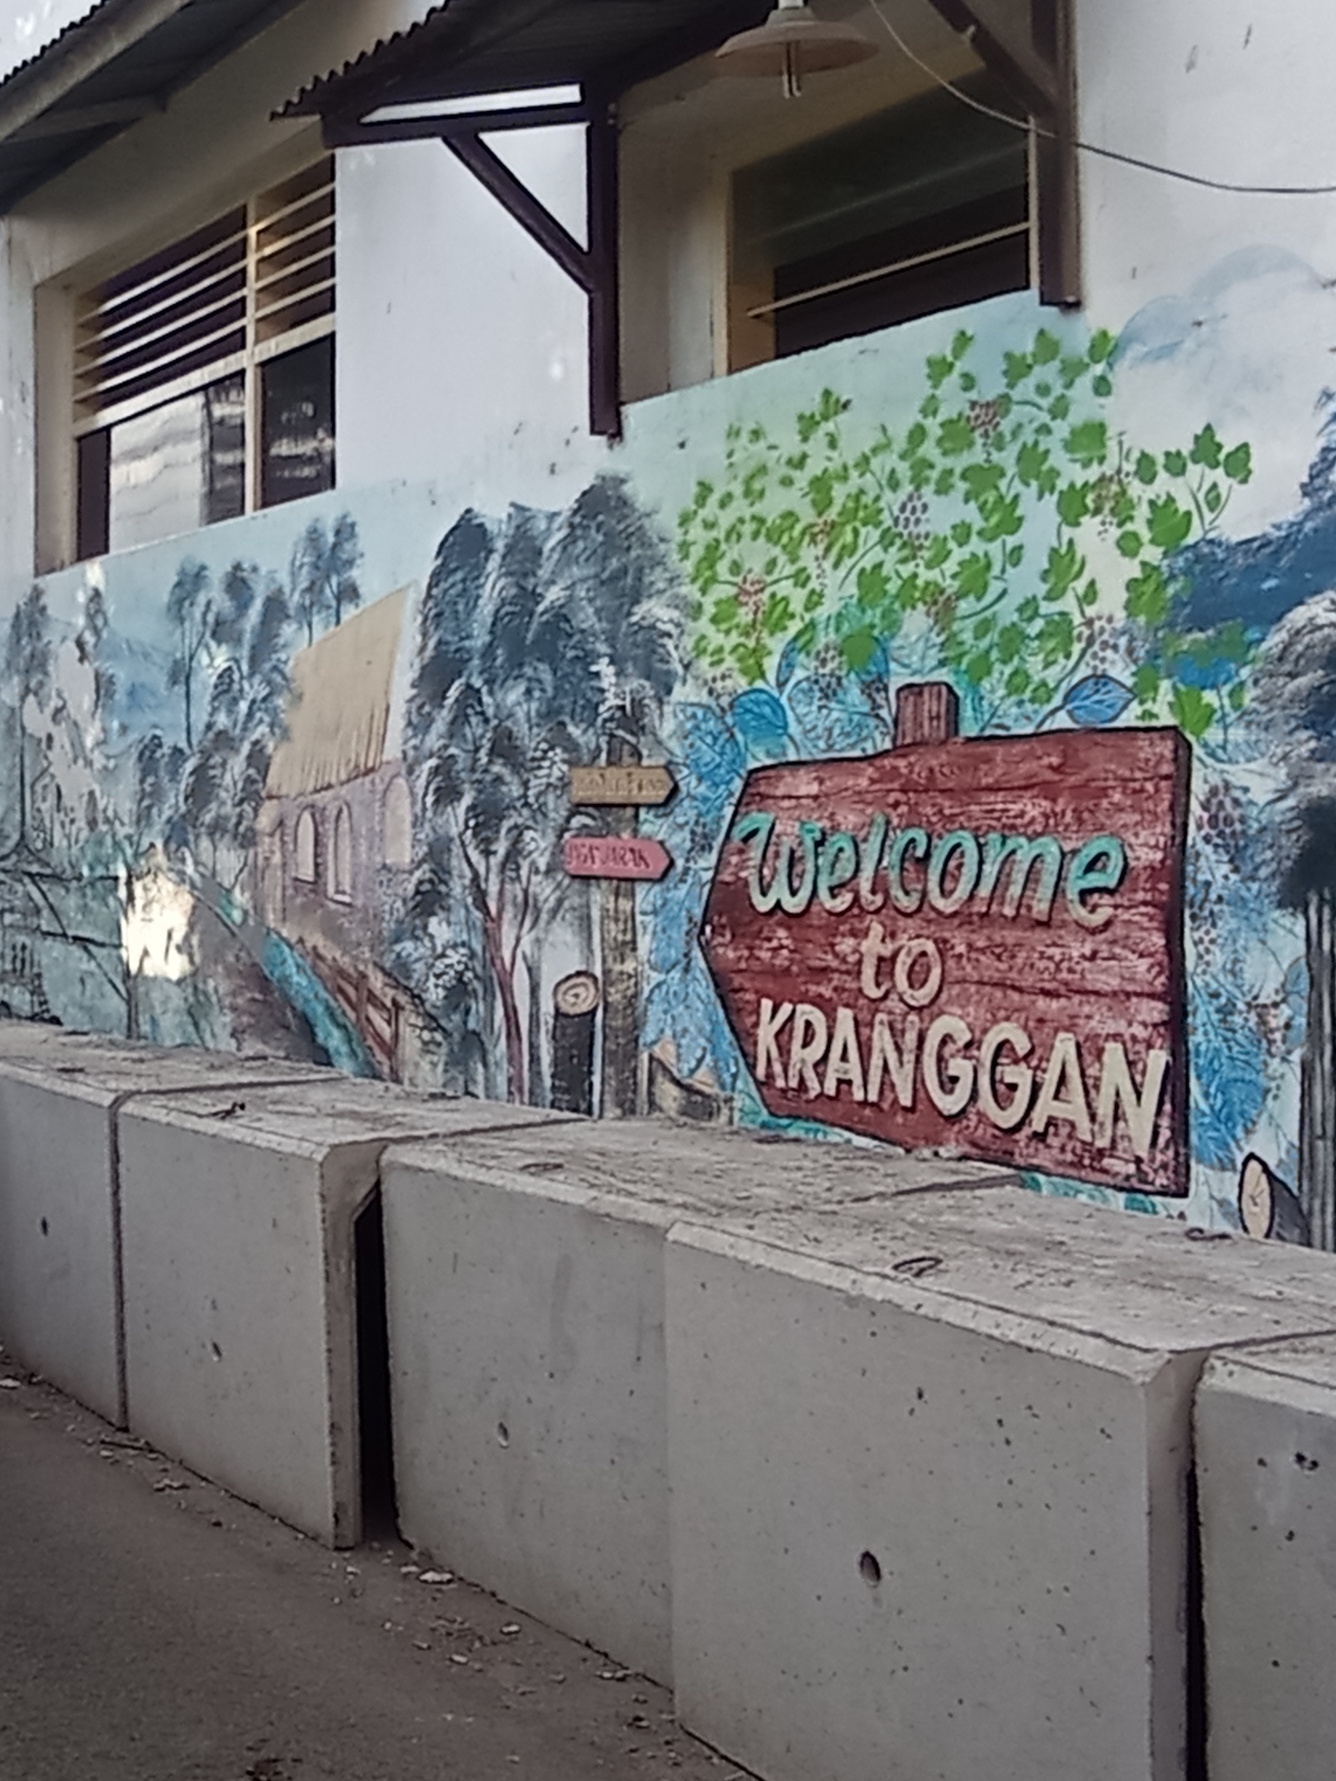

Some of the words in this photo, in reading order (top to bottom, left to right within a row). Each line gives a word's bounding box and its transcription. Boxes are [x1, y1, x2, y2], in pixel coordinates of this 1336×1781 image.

[730, 812, 1128, 929] Welcome
[860, 921, 944, 1008] to
[756, 998, 1167, 1155] KRANGGAN
